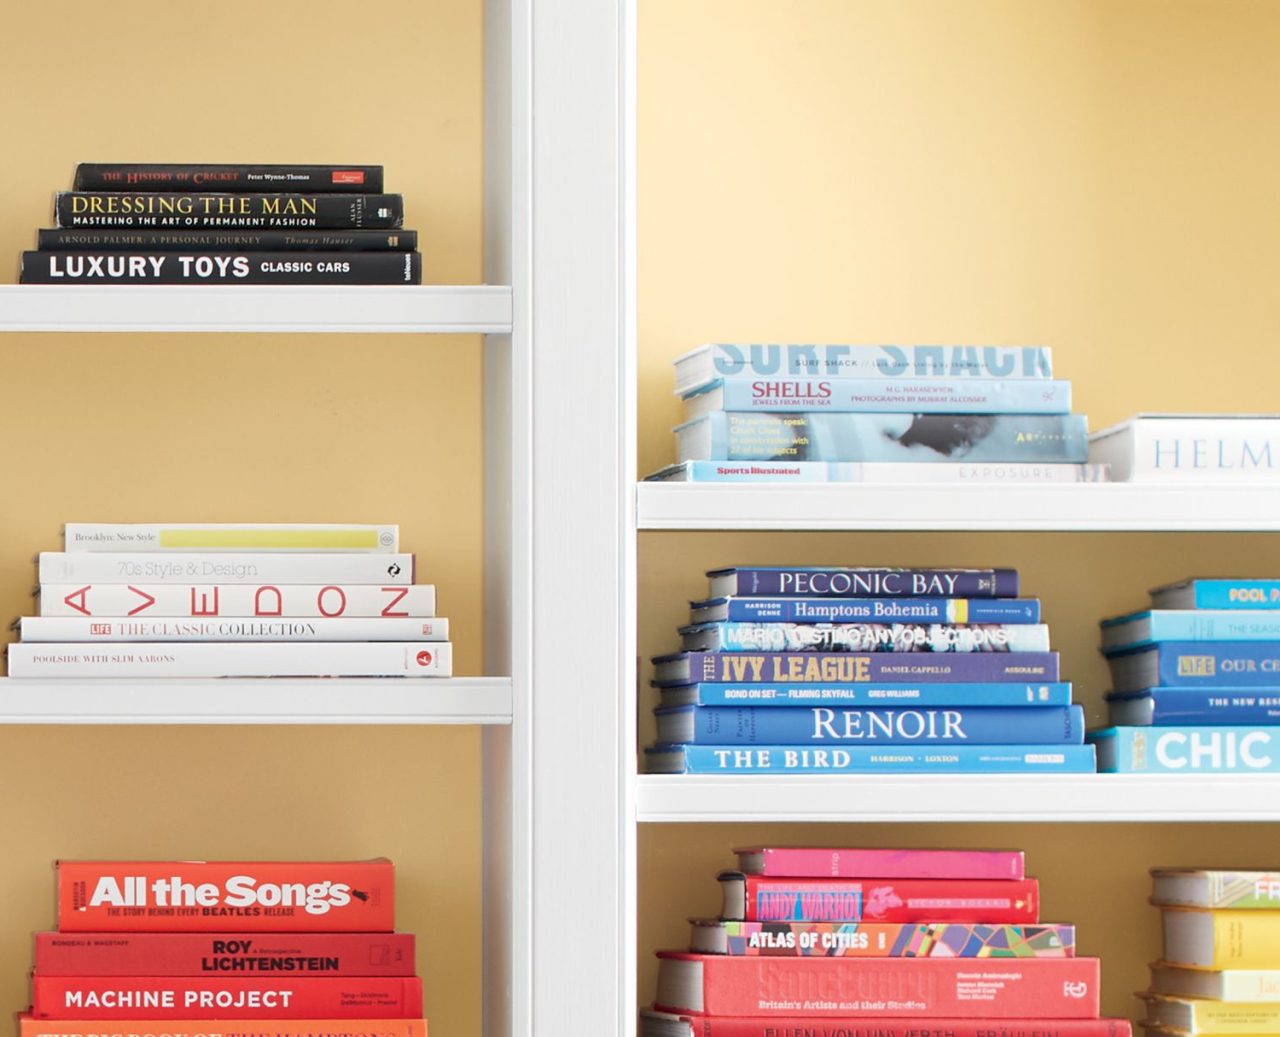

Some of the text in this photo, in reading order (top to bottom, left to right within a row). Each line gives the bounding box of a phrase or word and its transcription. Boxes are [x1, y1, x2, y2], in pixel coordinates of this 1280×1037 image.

[71, 196, 318, 216] DRESSING THE MAN
[73, 216, 317, 227] MASTERING THE ART OF PERMANENT FASHION
[49, 256, 350, 278] LUXURY TOYS CLASSIC CARS
[751, 381, 832, 399] SHELLS
[1153, 439, 1276, 468] HELM
[779, 572, 902, 594] PECONIC
[912, 574, 959, 595] BAY
[63, 585, 410, 617] AVEDON
[794, 602, 939, 621] Hamptons Bohemia
[32, 654, 176, 663] POOLSIDE WITH SLIM AARONS
[722, 656, 872, 682] IVY LEAGUE
[880, 666, 910, 674] DANIEL
[911, 666, 951, 674] CAPPELLO
[811, 708, 968, 740] RENOIR
[1155, 731, 1272, 768] CHIC
[89, 876, 147, 907] All
[151, 876, 220, 907] the
[223, 875, 351, 915] Songs
[107, 907, 296, 916] THE STORY BEHIND EVERY BEATLES RELEASE
[212, 940, 252, 954] ROY
[749, 932, 868, 948] ATLAS OF CITIES
[201, 957, 339, 971] LICHTENSTEIN
[65, 991, 293, 1008] MACHINE PROJECT
